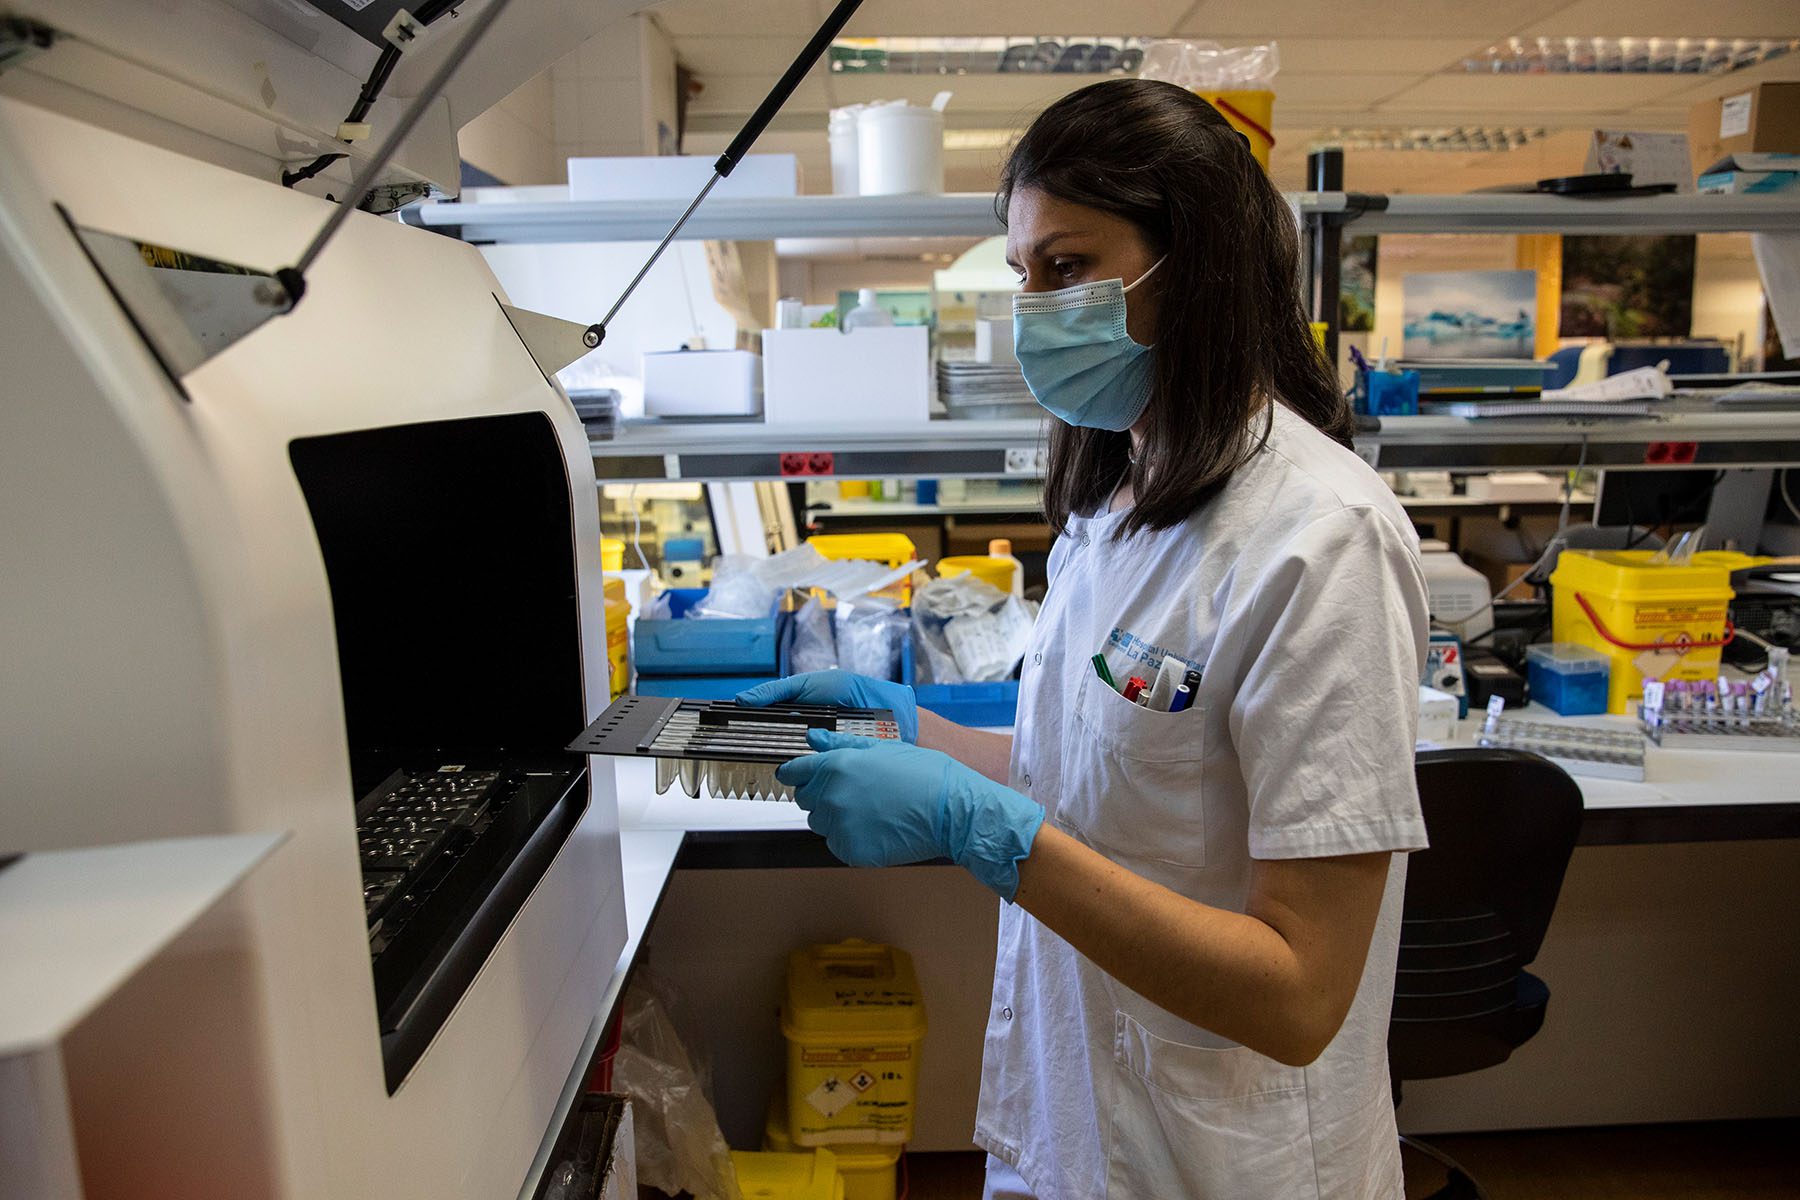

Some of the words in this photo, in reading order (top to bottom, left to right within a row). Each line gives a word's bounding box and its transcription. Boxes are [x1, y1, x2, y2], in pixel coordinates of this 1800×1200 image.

[1132, 636, 1160, 655] Hospital
[1127, 645, 1139, 660] La
[1139, 651, 1162, 669] Paz
